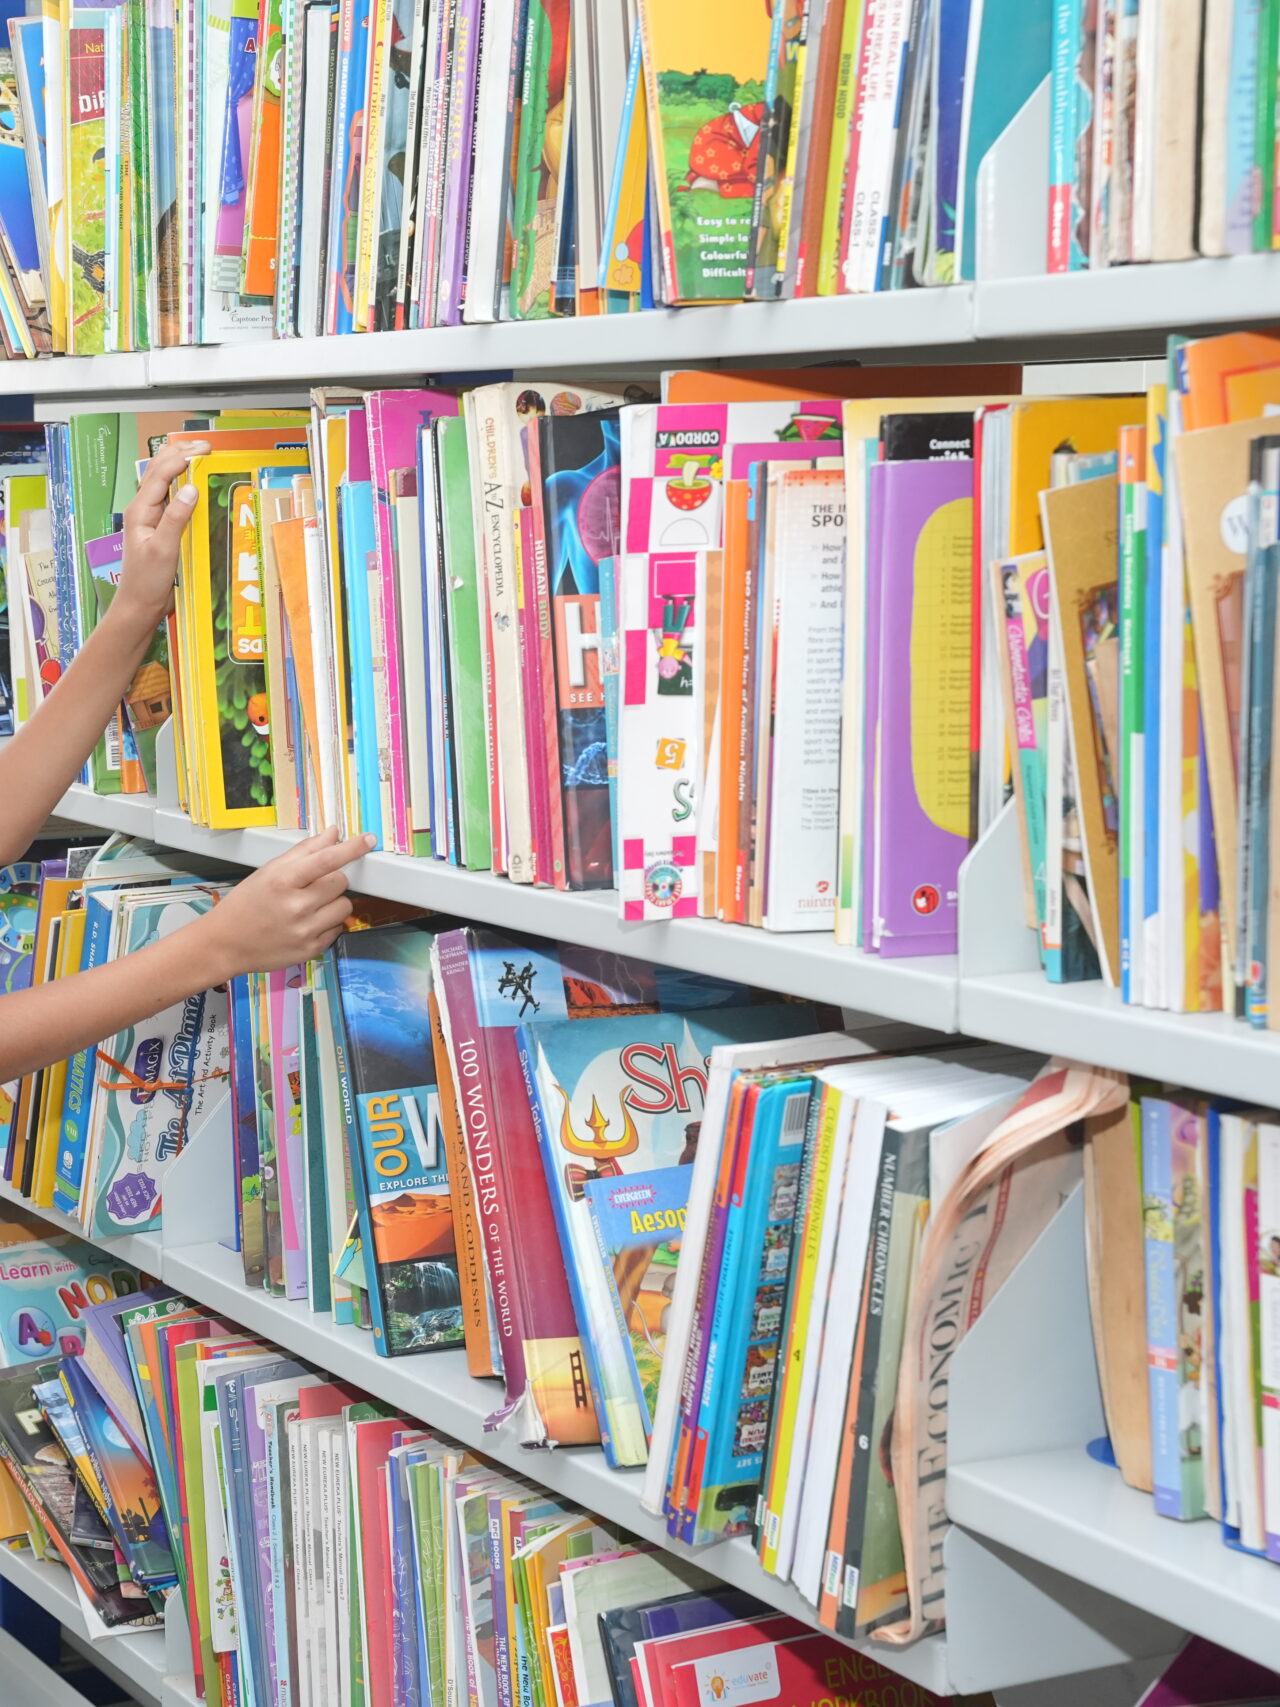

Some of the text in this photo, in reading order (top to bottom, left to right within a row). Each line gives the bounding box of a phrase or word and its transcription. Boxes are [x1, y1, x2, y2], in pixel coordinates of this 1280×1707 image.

[522, 18, 535, 106] ANCIENT CHINA
[338, 57, 348, 120] GRANDPA'S
[836, 53, 852, 120] ROBIN HOOD
[697, 217, 723, 230] Easy
[725, 216, 738, 226] to
[699, 234, 735, 245] Simple
[852, 191, 865, 248] CLASS-1
[866, 190, 881, 249] CLASS-2
[702, 267, 746, 278] Difficult
[231, 315, 260, 324] Capstone
[97, 425, 111, 487] Capstone Press
[483, 416, 498, 481] CHILDREN'S
[929, 438, 971, 451] Connect
[811, 504, 833, 513] THE
[811, 514, 844, 528] SPO
[490, 513, 505, 598] ENCYCLOPEDIA
[533, 539, 550, 640] HUMAN BODY
[744, 569, 752, 597] 100
[742, 599, 751, 650] Magical
[741, 653, 750, 686] Tales
[569, 692, 593, 704] SEE
[739, 705, 748, 757] Arabian
[738, 759, 747, 802] Nights
[735, 865, 743, 902] Shree
[209, 1014, 217, 1034] Book
[204, 1035, 215, 1067] Activity
[336, 1045, 347, 1075] OUR
[68, 1049, 87, 1114] MATICS
[198, 1085, 206, 1099] Art
[340, 1076, 353, 1125] WORLD
[519, 1049, 545, 1144] Shiva Tales
[155, 1118, 188, 1162] The
[366, 1094, 407, 1178] OUR
[379, 1176, 428, 1192] EXPLORE
[458, 1037, 513, 1338] 100 WONDERS OF THE WORLD
[460, 1161, 473, 1208] AND
[612, 1187, 654, 1205] EVERGREEN
[631, 1205, 689, 1235] Aesop
[868, 1151, 897, 1317] NUMBER CHRONICLES
[53, 1261, 77, 1276] with
[465, 1212, 482, 1328] GODDESSES
[6, 1457, 48, 1523] ARCHAEOLOGY
[491, 1519, 501, 1570] APC BOOKS
[498, 1637, 507, 1652] THE
[500, 1654, 508, 1674] NEW
[501, 1675, 510, 1694] BOOK
[731, 1669, 769, 1687] eduvate
